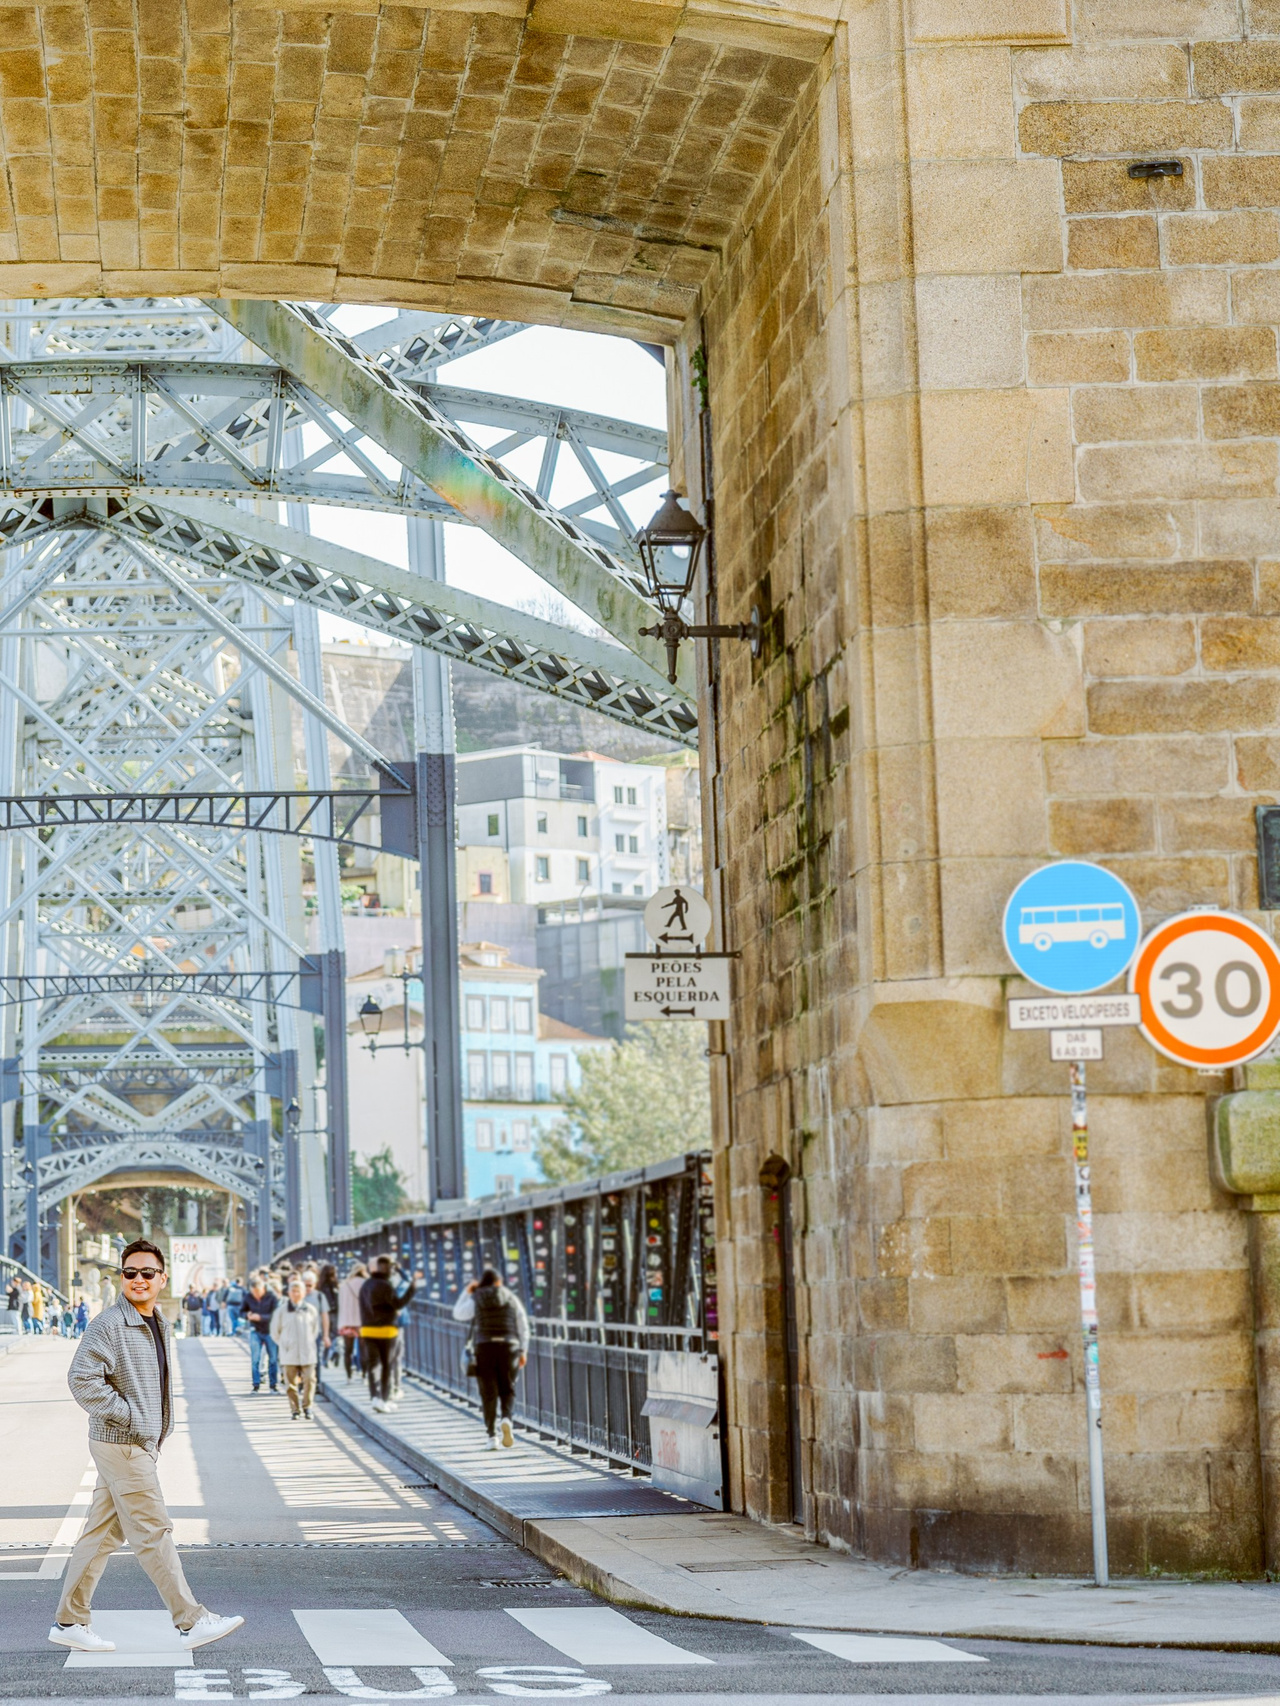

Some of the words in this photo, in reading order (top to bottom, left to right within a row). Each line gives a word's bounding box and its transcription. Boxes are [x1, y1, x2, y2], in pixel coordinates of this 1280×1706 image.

[651, 960, 702, 974] PEÕES
[656, 976, 697, 988] PELA
[1159, 960, 1262, 1019] 30
[634, 991, 720, 1004] ESQUERDA
[1019, 1005, 1059, 1021] EXCETO
[1066, 1033, 1087, 1043] DAS
[173, 1243, 198, 1253] GAIA
[173, 1253, 198, 1263] FOLK
[174, 1665, 613, 1701] BUS
